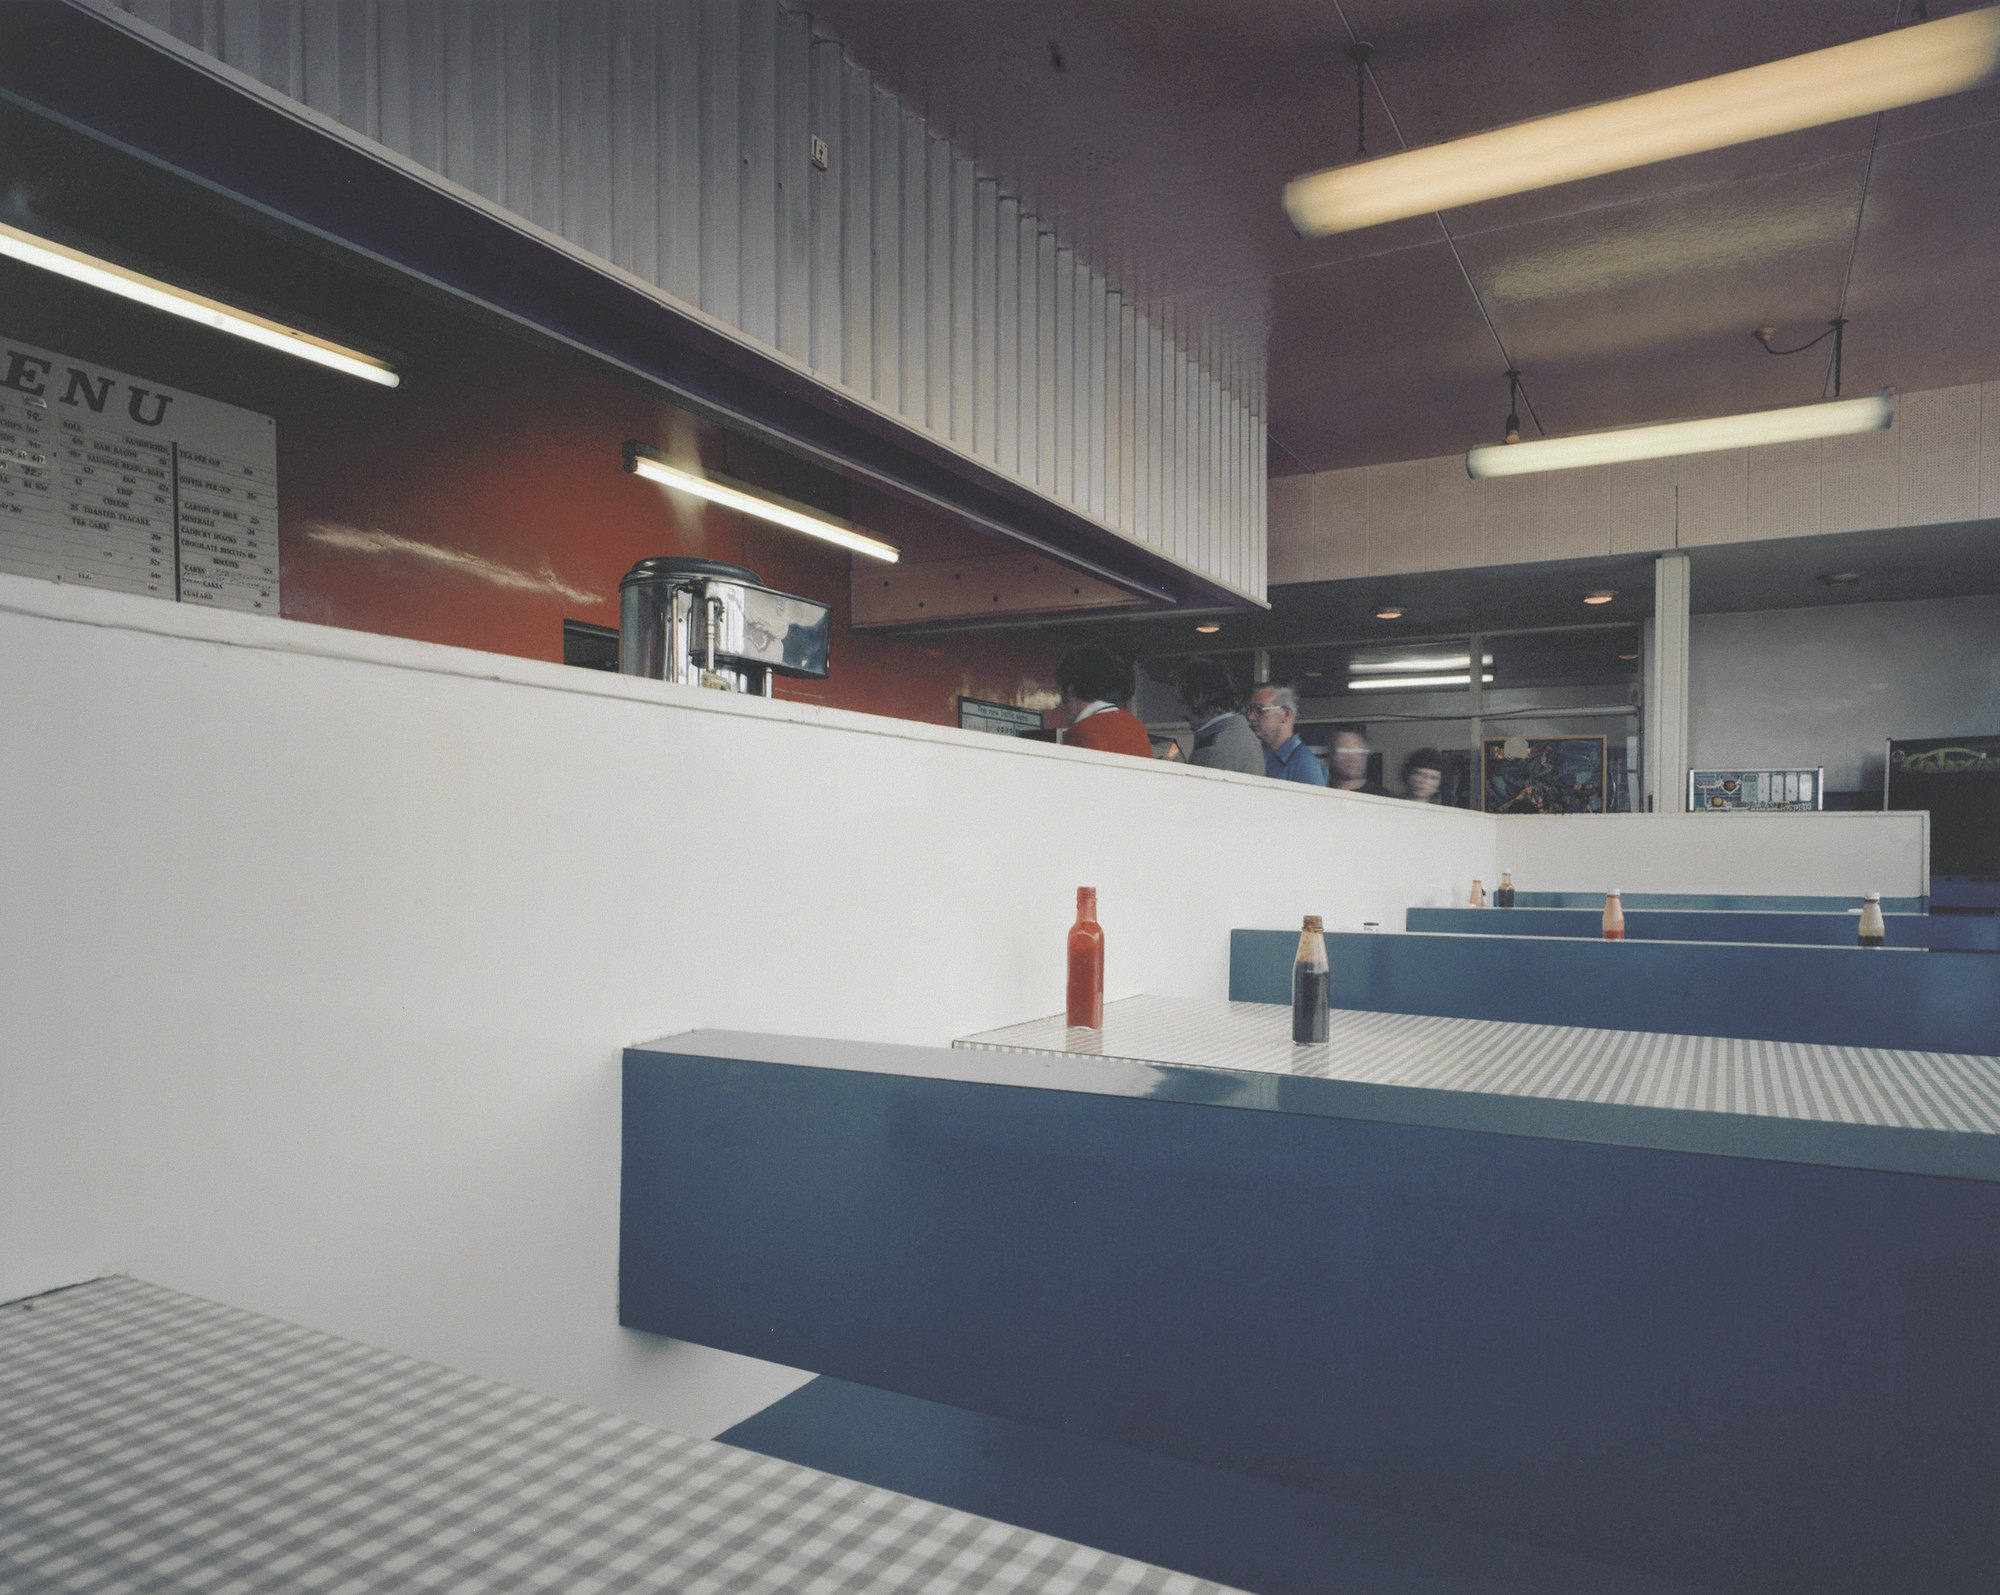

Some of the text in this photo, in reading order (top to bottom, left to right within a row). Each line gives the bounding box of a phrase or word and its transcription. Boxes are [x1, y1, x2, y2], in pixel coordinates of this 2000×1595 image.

[63, 421, 83, 432] ROLL
[113, 447, 137, 458] BACON
[180, 450, 193, 460] TEA
[194, 454, 207, 464] PER
[87, 454, 120, 467] SAUSAGE
[205, 481, 218, 491] PER
[103, 497, 130, 509] CHEESE
[82, 505, 116, 519] TOASTED
[118, 512, 150, 526] TEACAKE
[184, 502, 211, 514] CARTON
[222, 510, 238, 520] MILK
[72, 517, 86, 527] TEA
[181, 513, 216, 527] MINERALS
[180, 525, 212, 539] CADBURY
[213, 532, 237, 544] SNACKS
[180, 538, 218, 553] CHOCOLATE
[212, 557, 240, 569] BISCUITS
[184, 565, 206, 575] CAKES
[202, 580, 223, 590] CAKES
